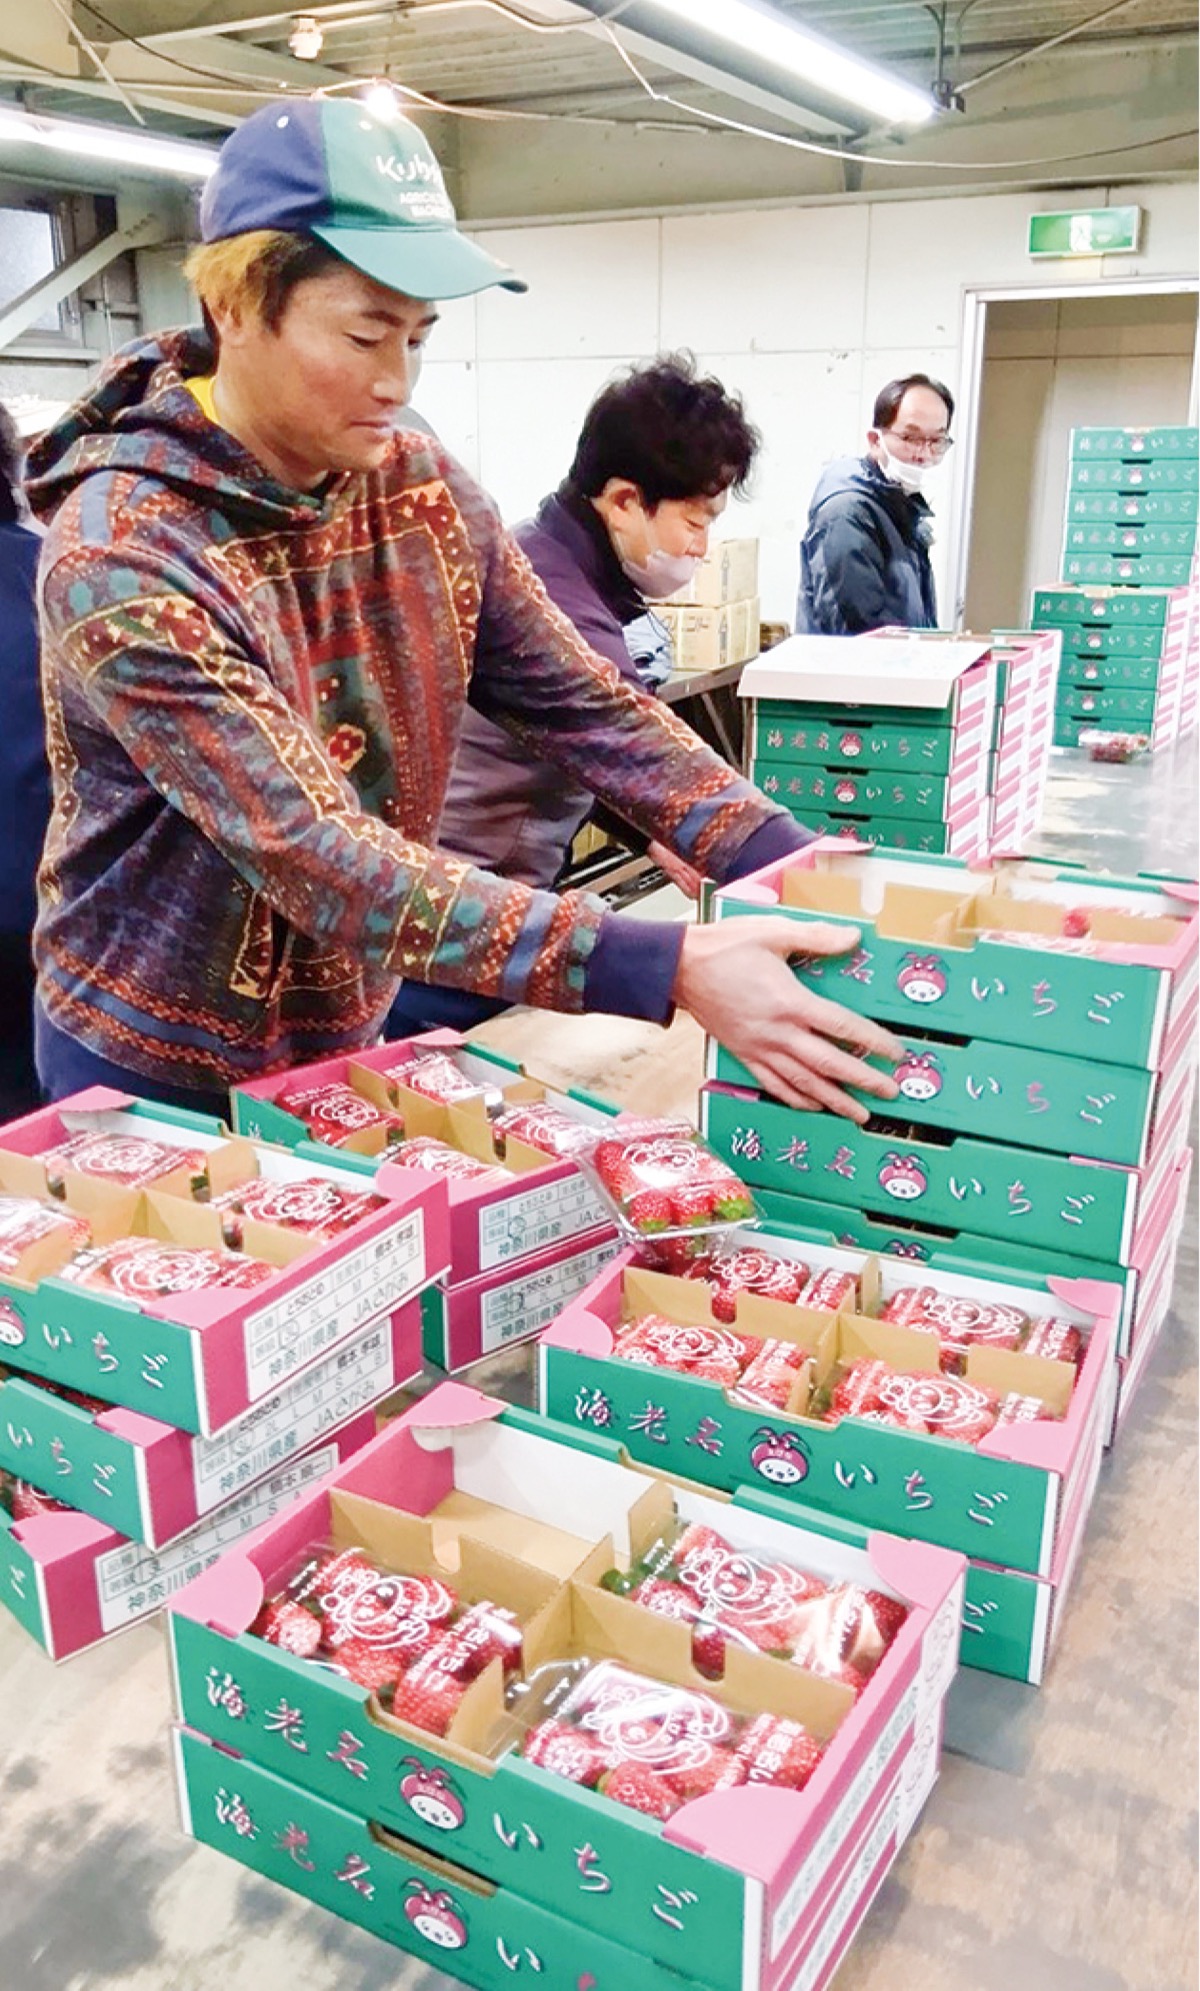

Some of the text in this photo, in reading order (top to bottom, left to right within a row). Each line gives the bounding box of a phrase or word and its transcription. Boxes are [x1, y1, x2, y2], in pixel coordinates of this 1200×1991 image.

[971, 976, 1125, 1024] いちご
[965, 1074, 1116, 1124] いちご
[730, 1127, 1095, 1225] 海老名 いちご
[42, 1323, 169, 1388] いちご
[7, 1422, 116, 1497] いちご
[574, 1386, 1010, 1527] 海老名 いちご
[205, 1666, 369, 1781] 海老名
[493, 1812, 699, 1930] いちご
[215, 1786, 375, 1901] 海老名
